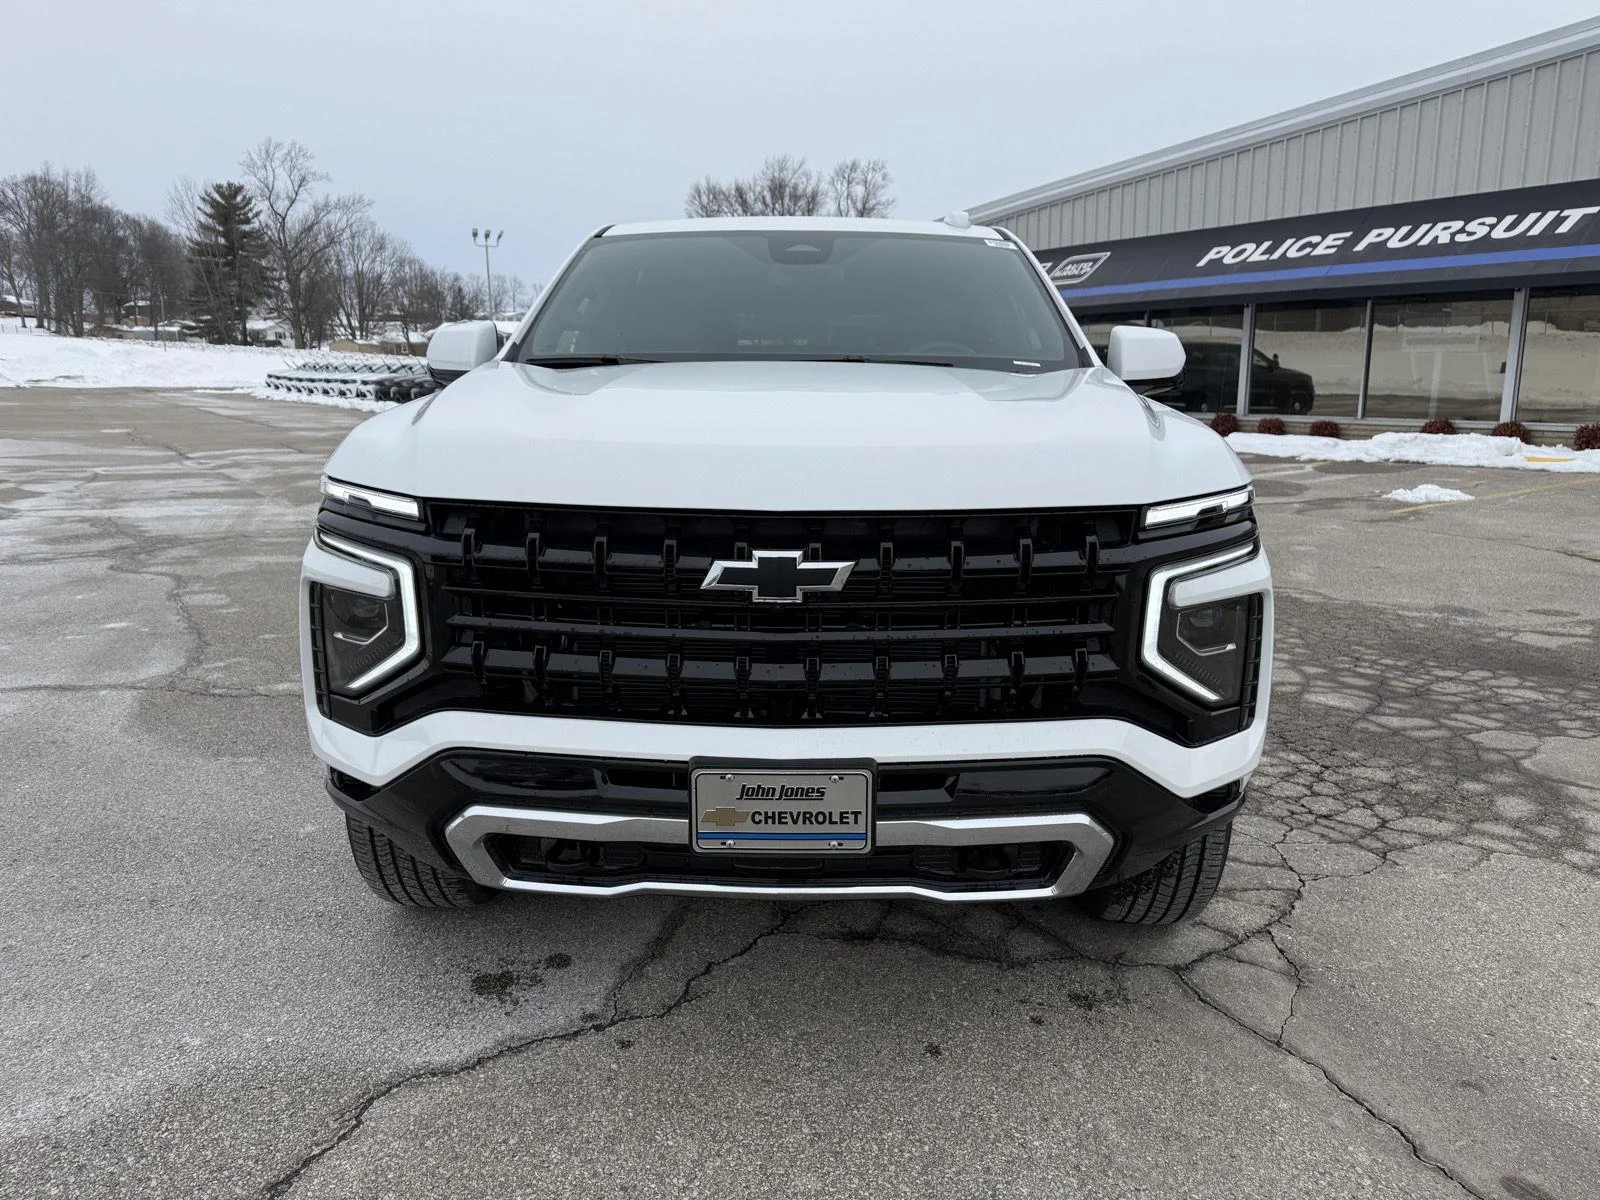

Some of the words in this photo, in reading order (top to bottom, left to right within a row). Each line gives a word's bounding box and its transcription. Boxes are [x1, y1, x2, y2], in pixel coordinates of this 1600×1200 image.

[1195, 231, 1353, 268] POLICE
[1352, 206, 1600, 252] PURSUIT
[736, 783, 776, 800] John
[775, 784, 827, 800] Jones
[750, 810, 862, 825] CHEVROLET
